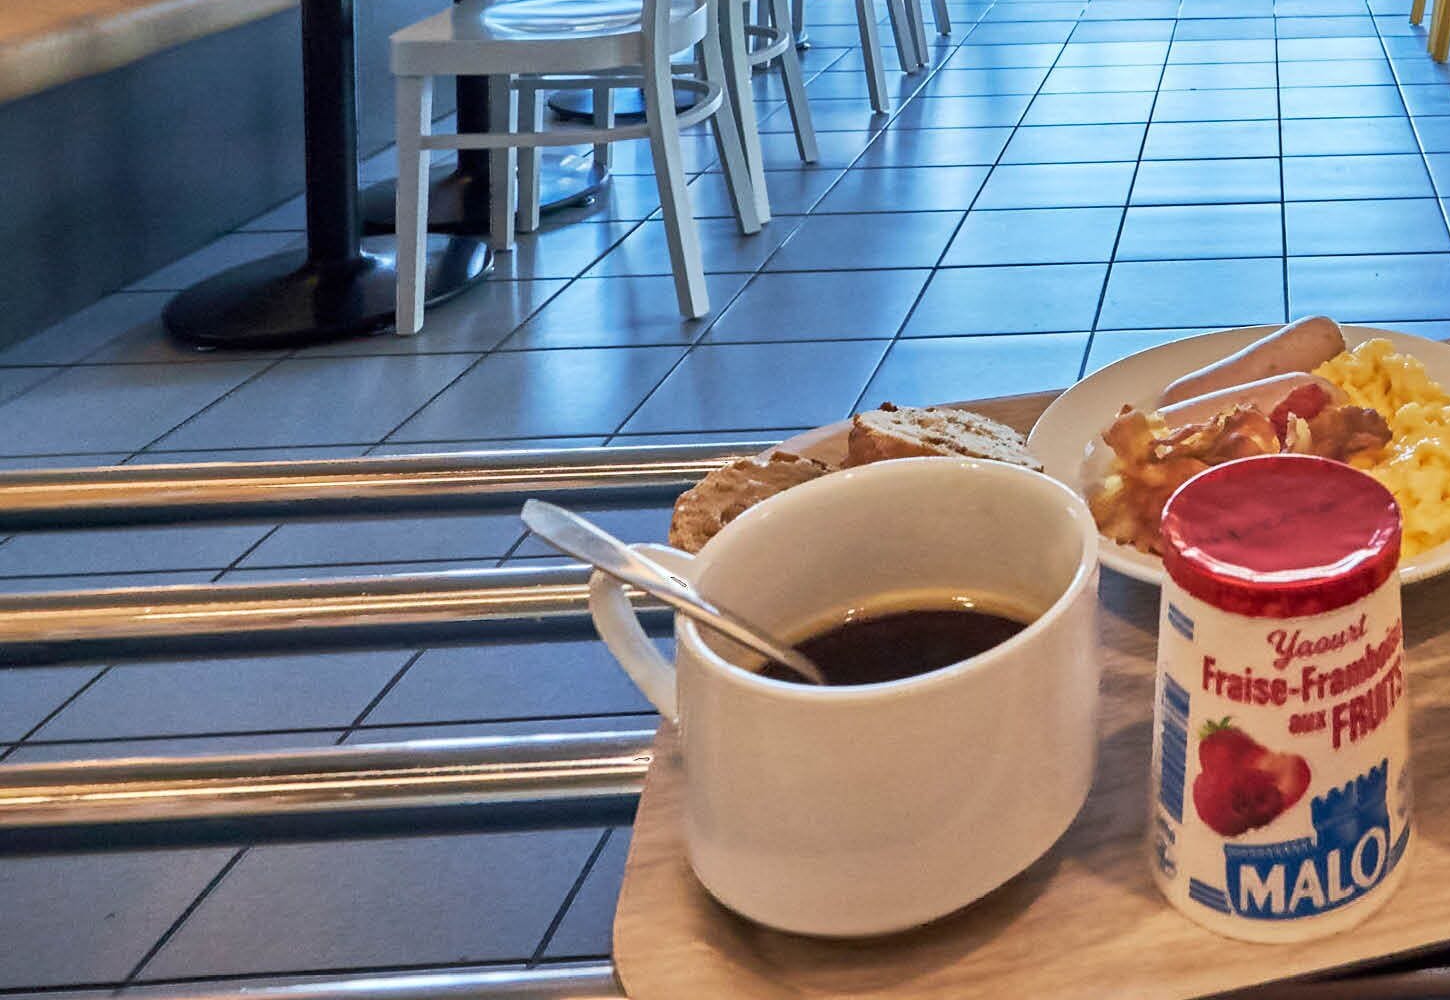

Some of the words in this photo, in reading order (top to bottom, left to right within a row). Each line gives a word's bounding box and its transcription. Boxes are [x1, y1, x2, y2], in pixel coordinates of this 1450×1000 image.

[1267, 613, 1367, 670] Yaourt
[1289, 710, 1327, 735] aux
[1239, 827, 1386, 914] MALO
